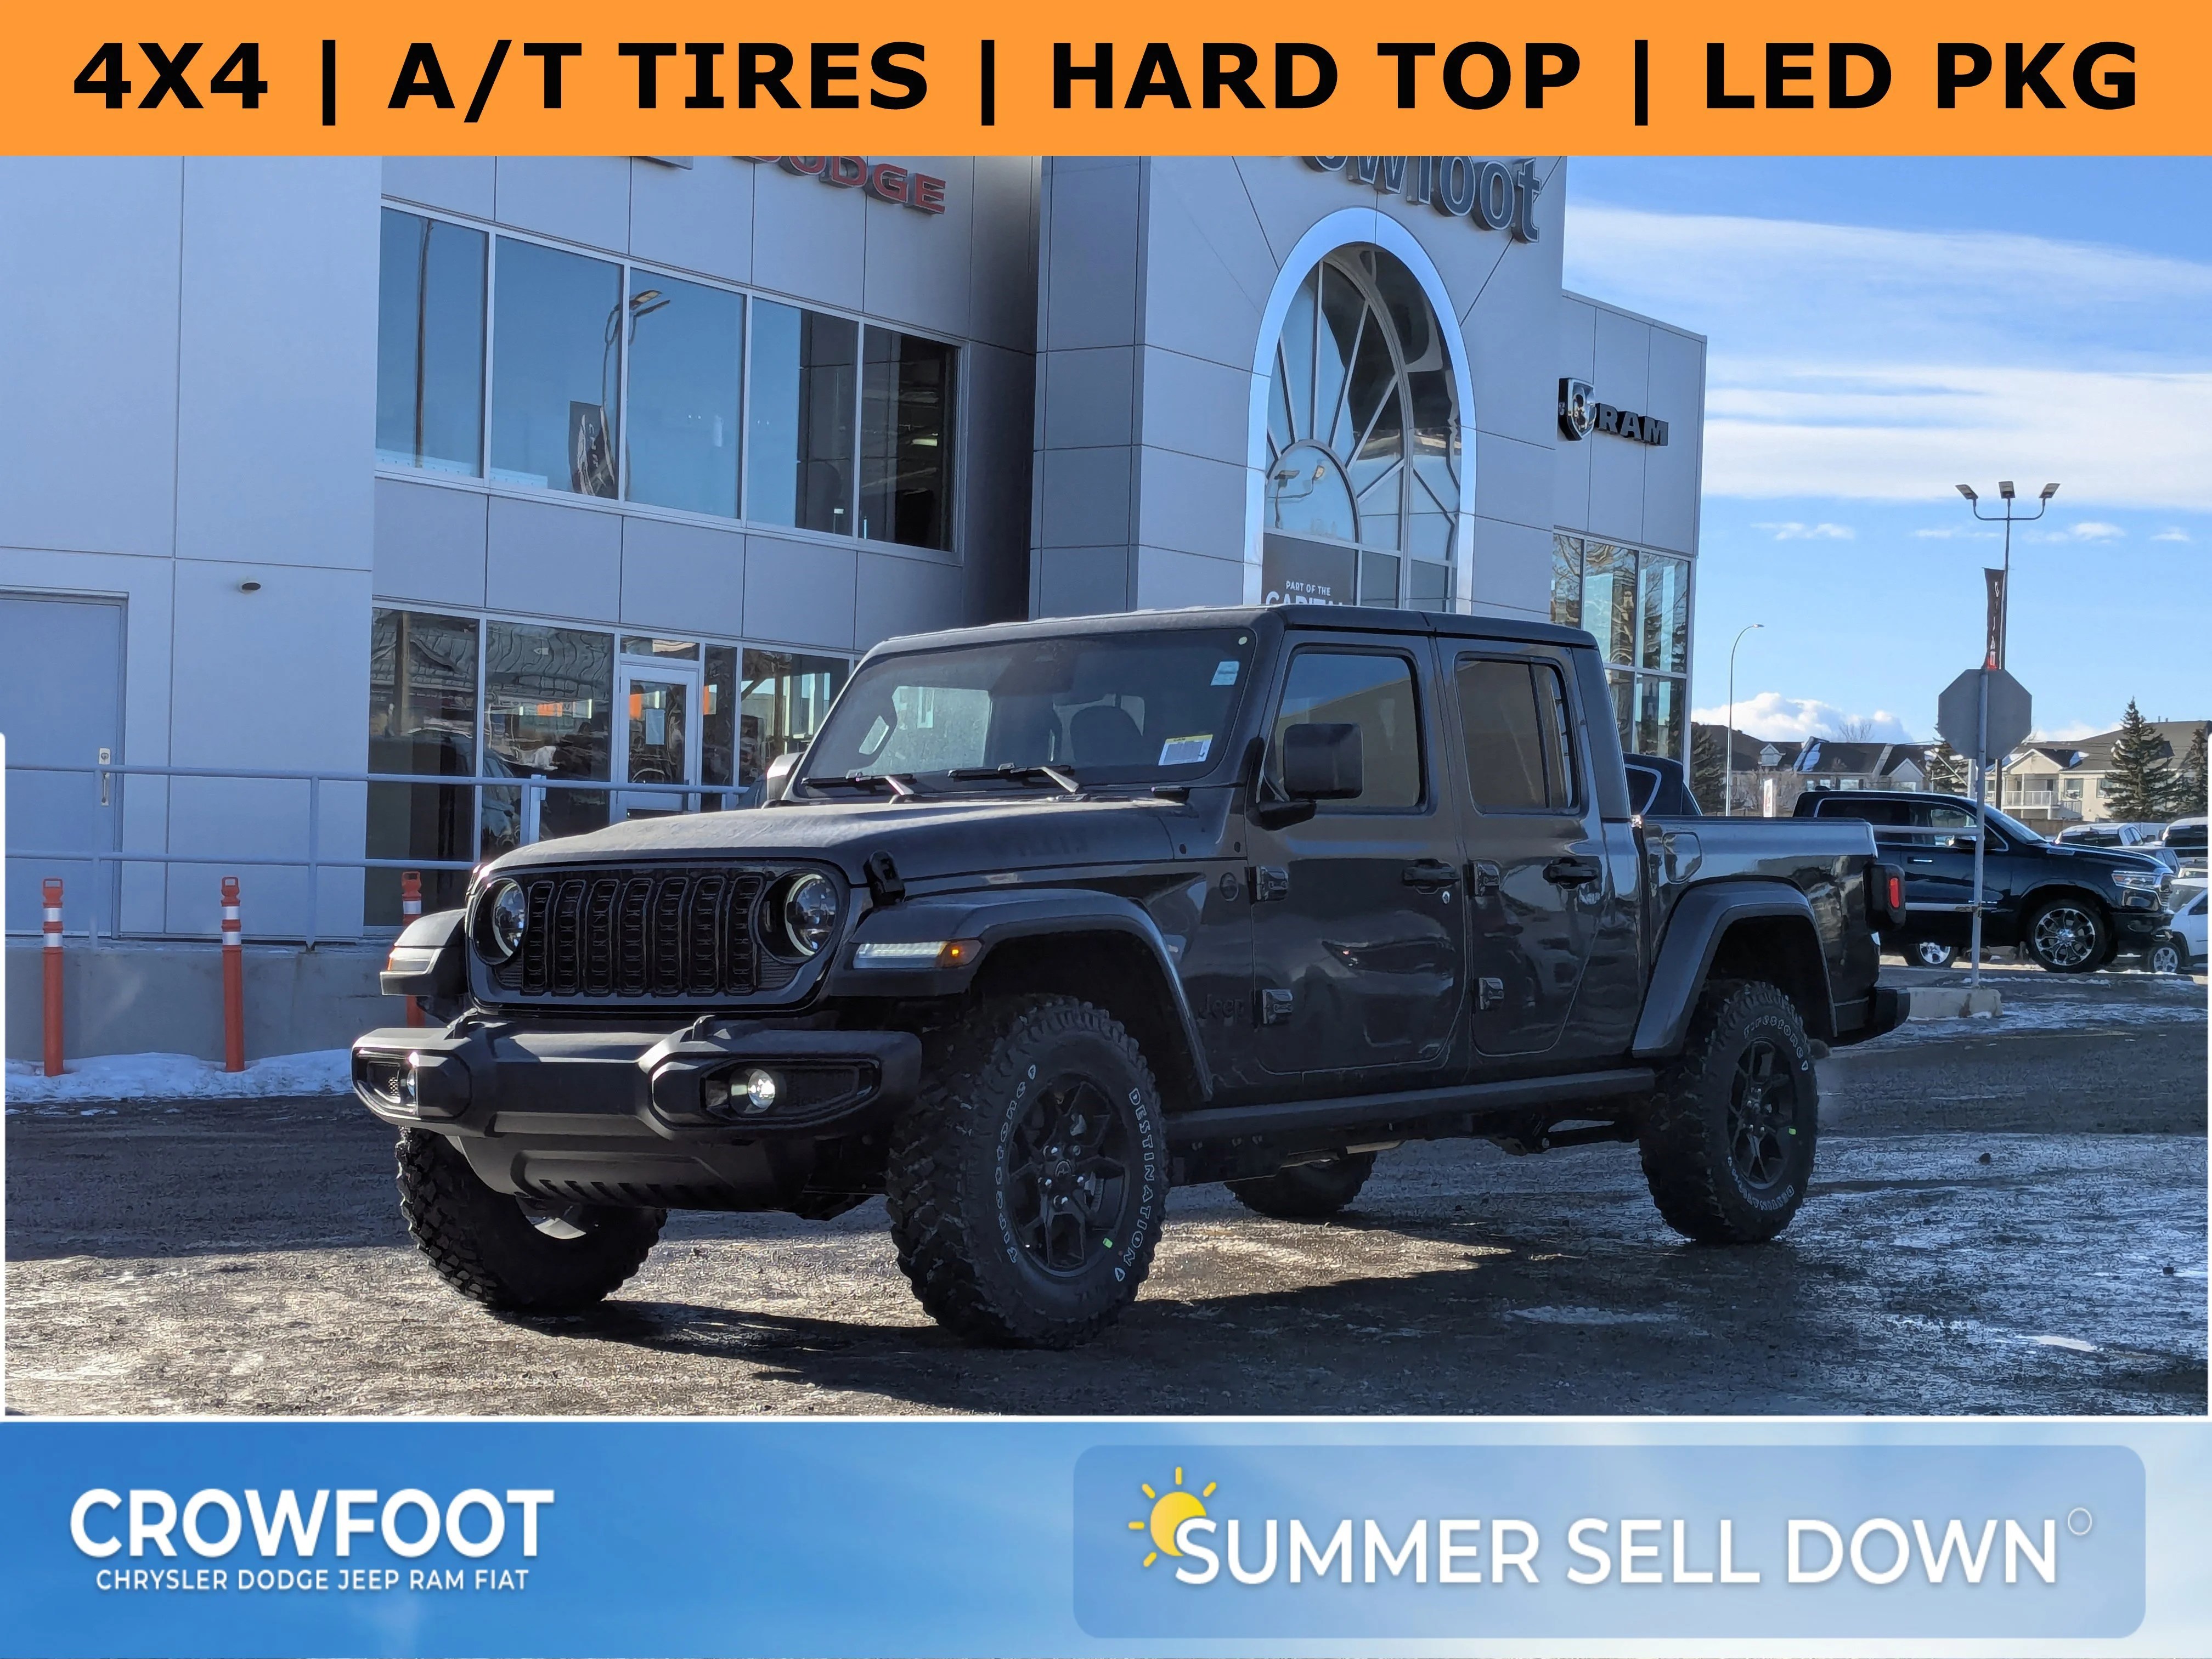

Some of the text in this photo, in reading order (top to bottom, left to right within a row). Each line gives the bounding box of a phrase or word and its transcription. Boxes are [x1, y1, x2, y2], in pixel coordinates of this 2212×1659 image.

[1597, 403, 1669, 447] RAM
[1285, 580, 1331, 596] PART OF THE
[1122, 1087, 1155, 1267] DESTINATION
